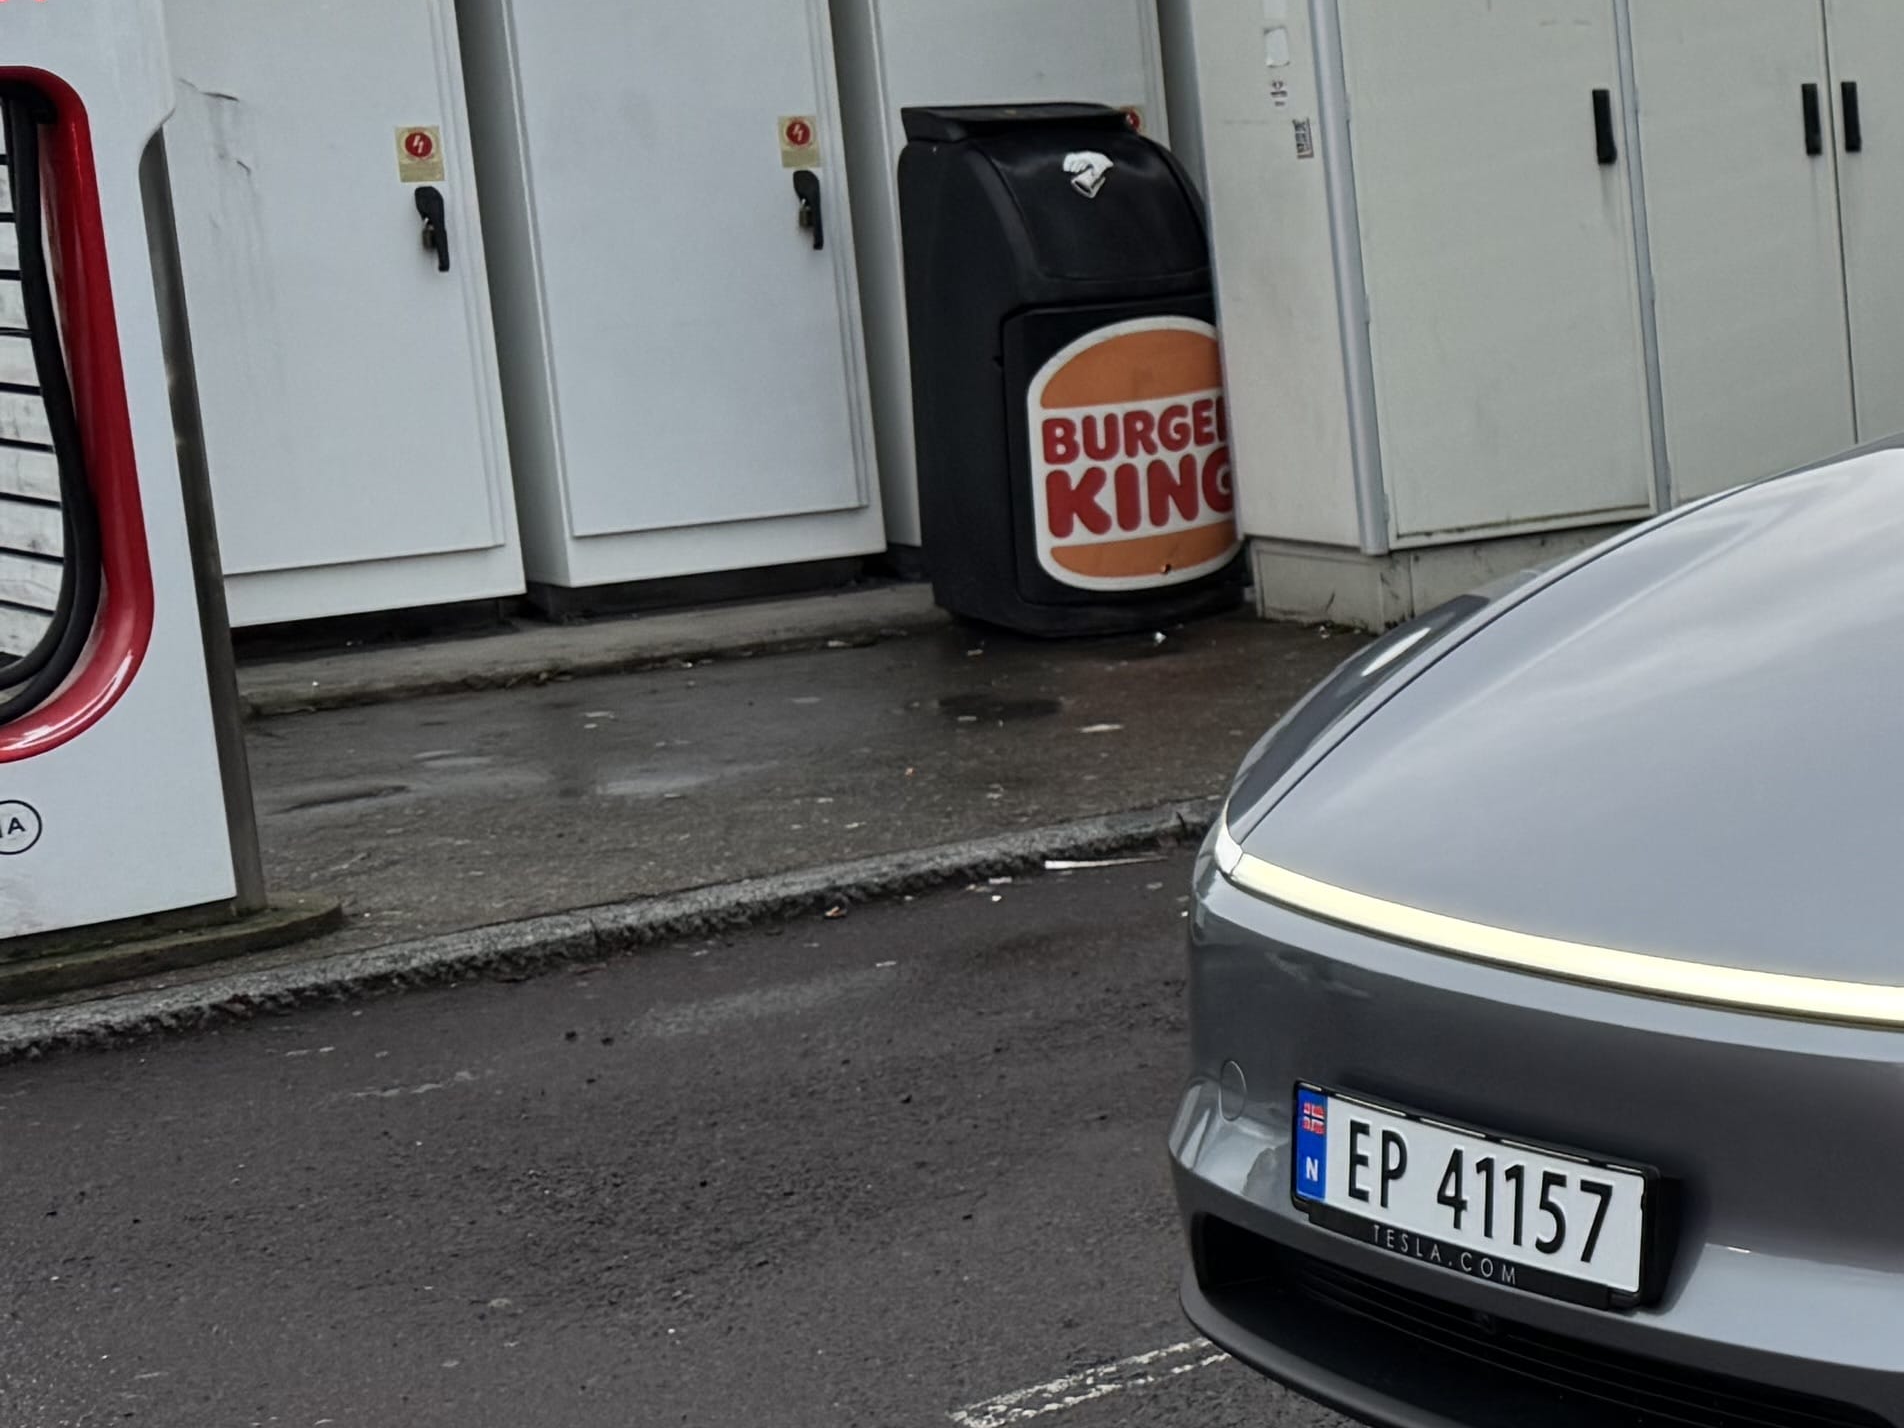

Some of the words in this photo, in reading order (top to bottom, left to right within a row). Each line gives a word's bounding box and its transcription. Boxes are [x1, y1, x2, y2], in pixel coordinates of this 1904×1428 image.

[1046, 446, 1234, 539] KING
[1306, 1157, 1319, 1182] N
[1348, 1119, 1408, 1210] EP
[1437, 1148, 1614, 1263] 41157
[1373, 1224, 1516, 1285] TESLA.COM
